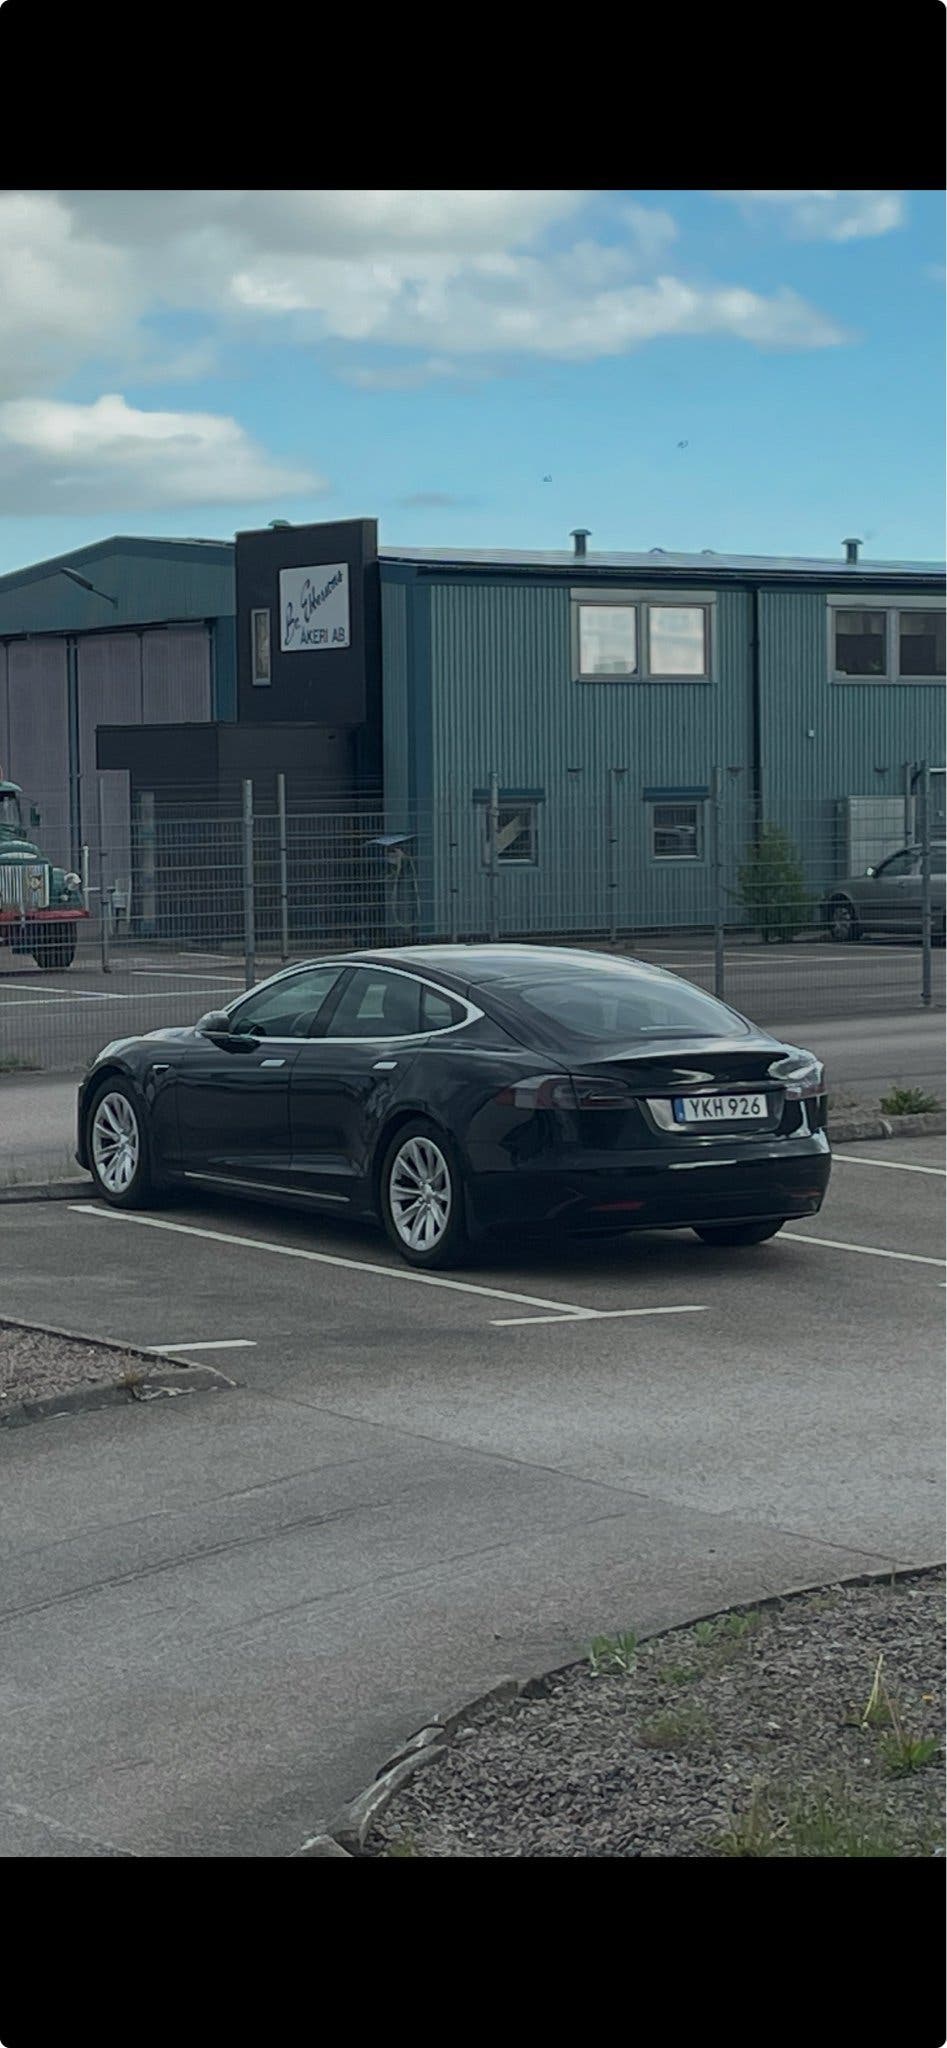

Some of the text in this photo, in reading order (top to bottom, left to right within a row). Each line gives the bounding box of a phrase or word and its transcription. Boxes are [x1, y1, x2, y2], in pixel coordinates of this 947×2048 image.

[331, 627, 346, 643] AB
[689, 1097, 761, 1118] YKH 926
